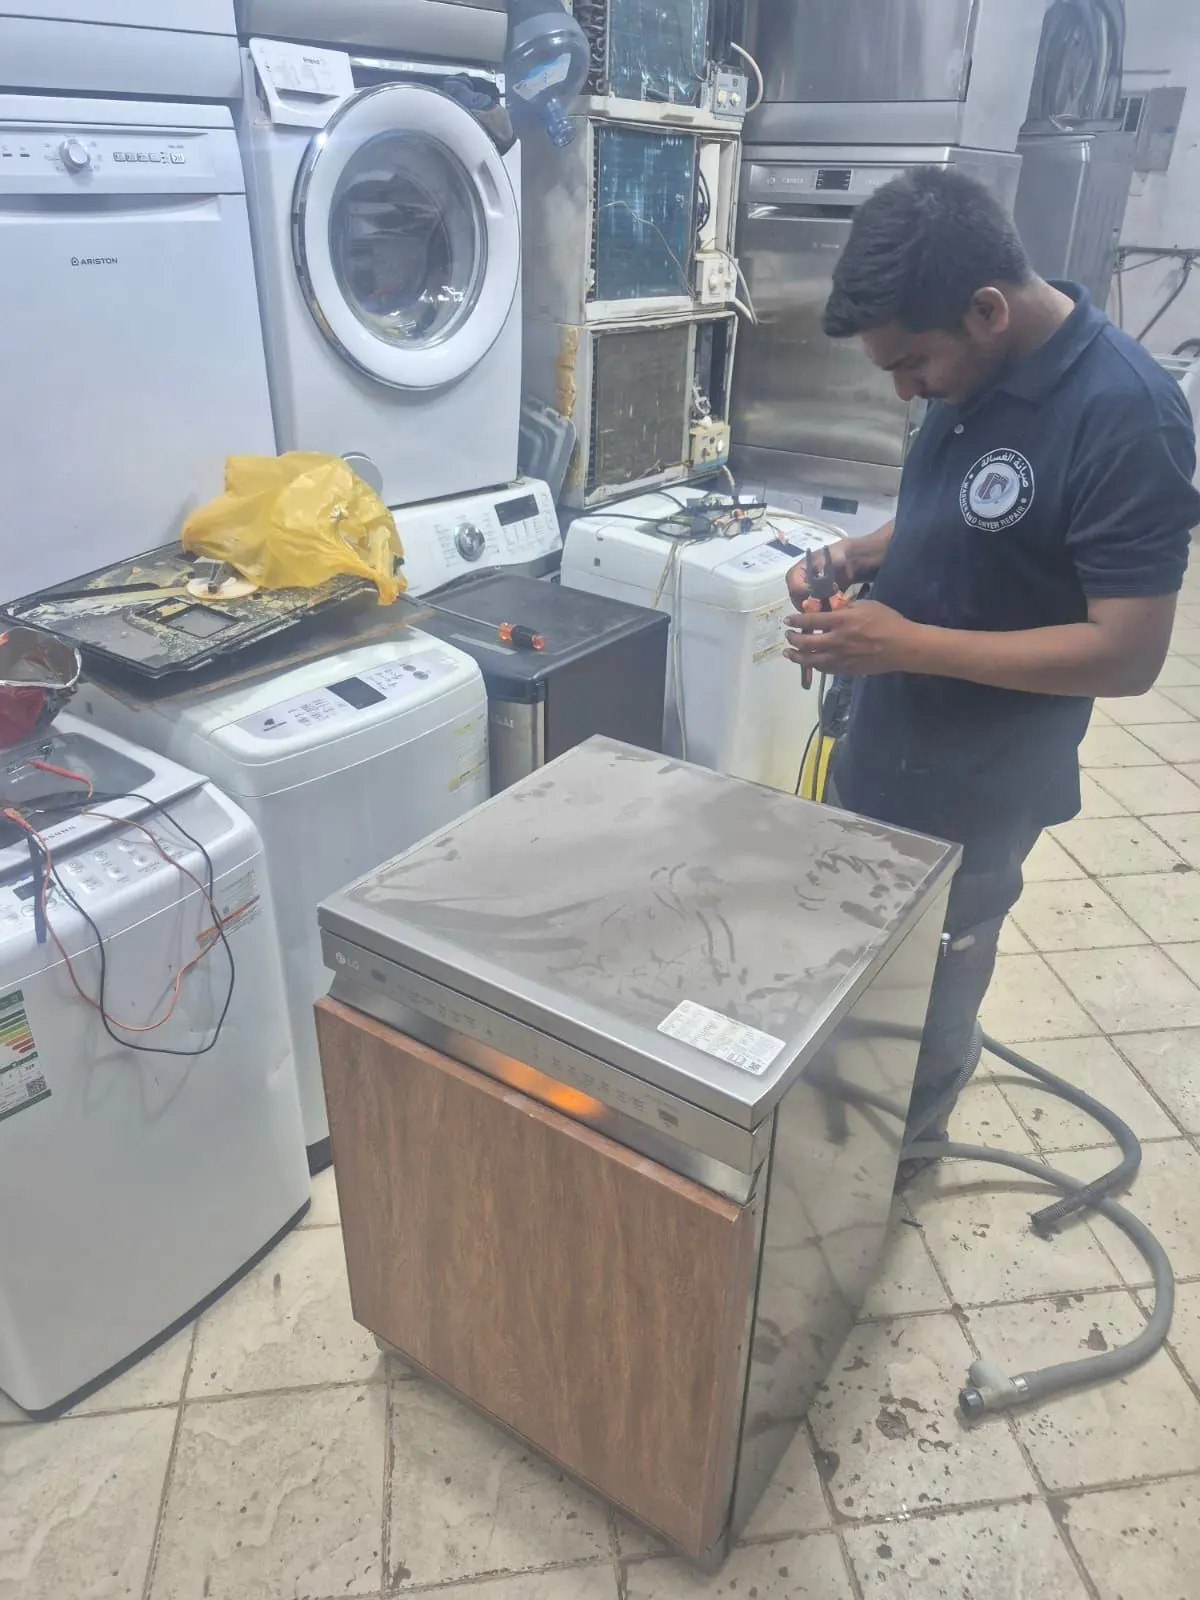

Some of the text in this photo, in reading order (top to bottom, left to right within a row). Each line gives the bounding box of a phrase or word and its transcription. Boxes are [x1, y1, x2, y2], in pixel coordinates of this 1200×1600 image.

[81, 257, 118, 265] ARISTON
[981, 452, 1029, 488] صيانة الغسالة
[1000, 505, 1026, 526] REPAIR
